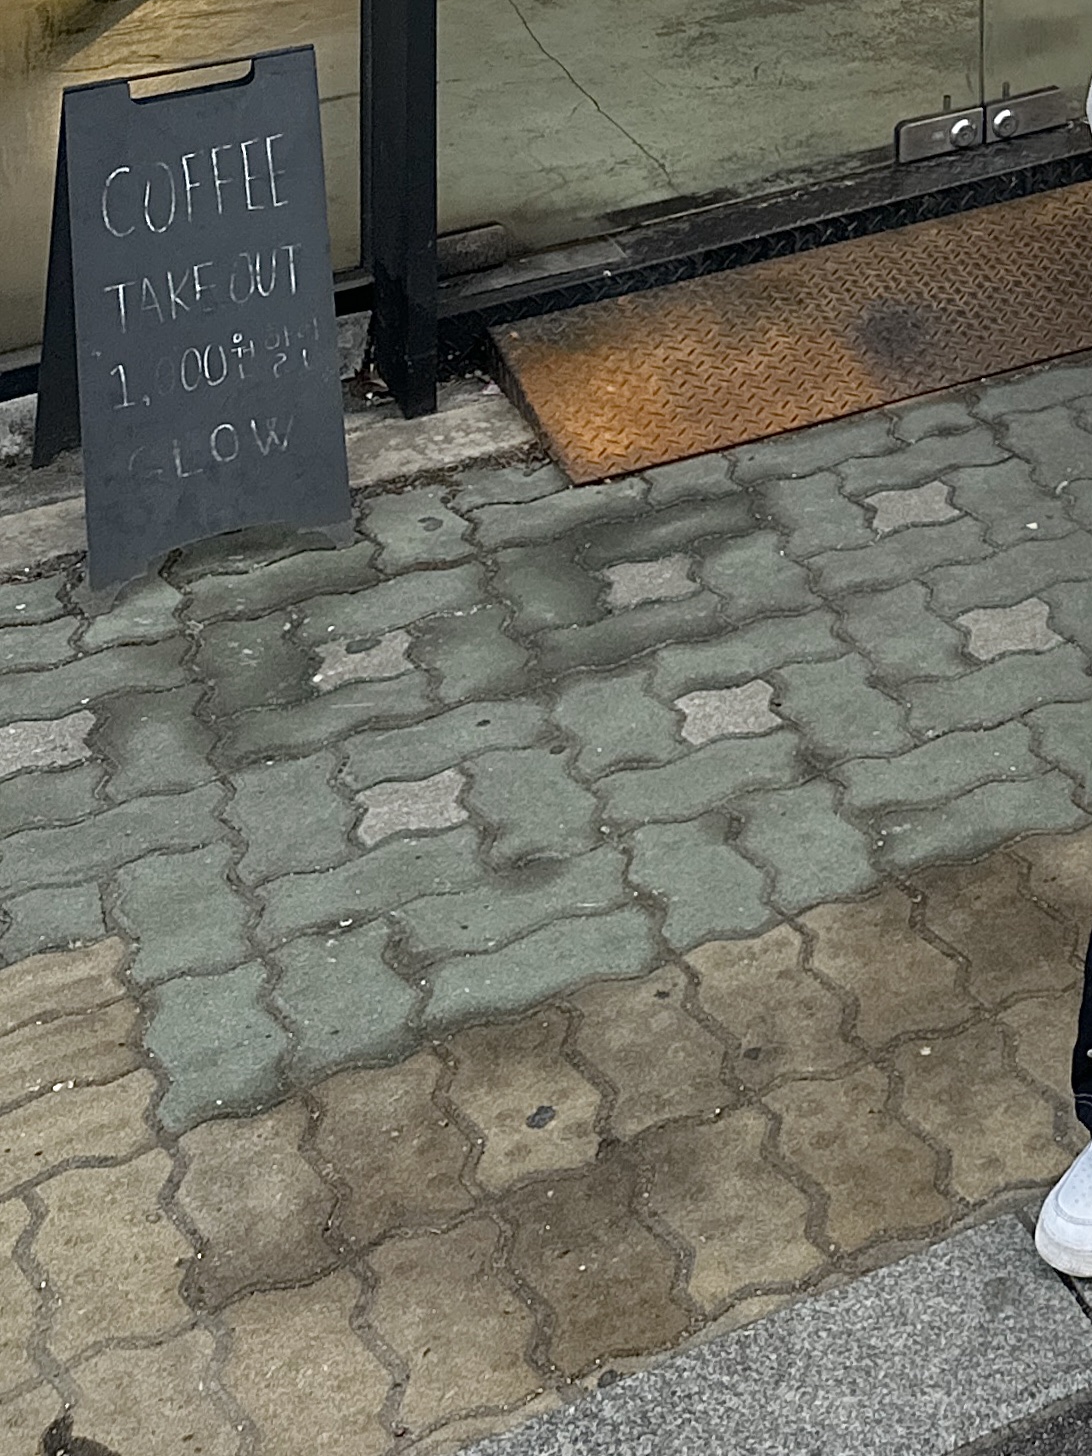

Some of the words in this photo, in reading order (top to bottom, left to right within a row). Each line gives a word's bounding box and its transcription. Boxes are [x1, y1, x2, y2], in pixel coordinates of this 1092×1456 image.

[101, 132, 290, 238] COFFEE
[103, 259, 217, 334] TAKE
[228, 244, 303, 306] OUT
